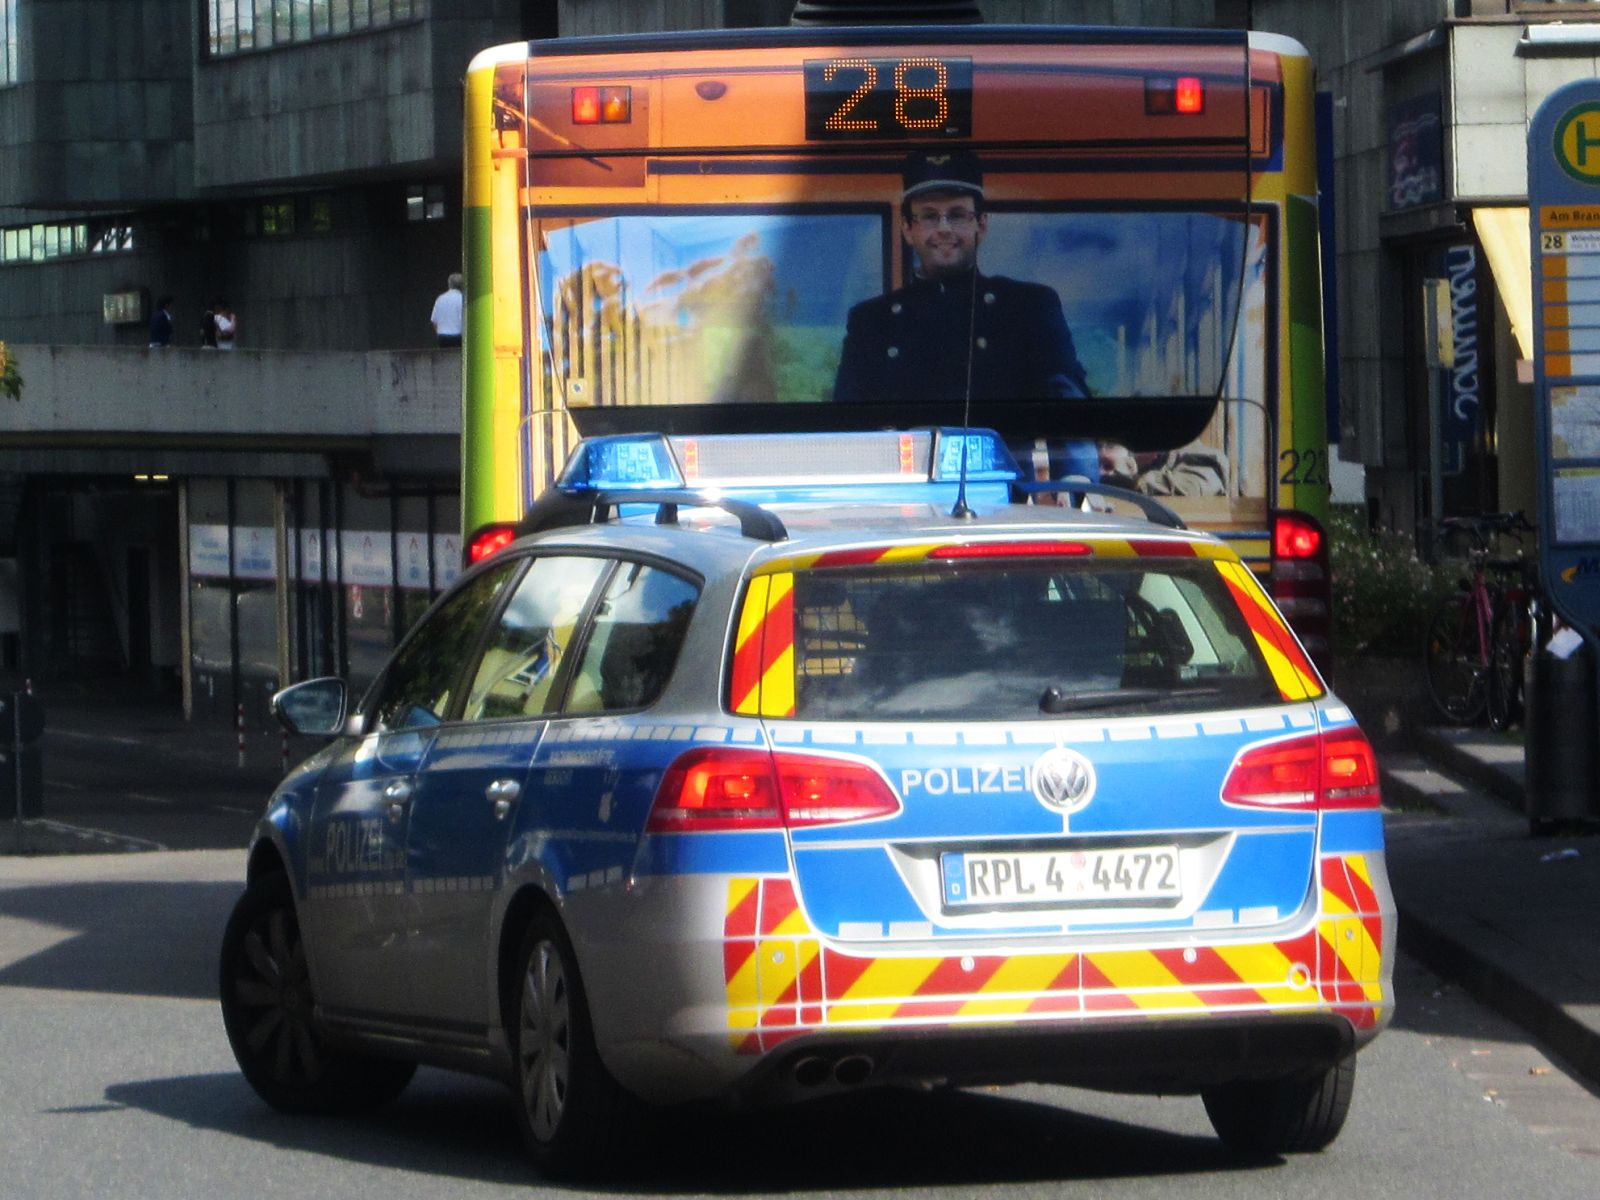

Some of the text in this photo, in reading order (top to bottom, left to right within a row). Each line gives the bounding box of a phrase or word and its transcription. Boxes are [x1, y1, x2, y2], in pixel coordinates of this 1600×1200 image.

[824, 58, 947, 129] 28
[1550, 210, 1570, 221] Am
[1543, 234, 1563, 249] 28
[902, 766, 1031, 796] POLIZEI
[968, 853, 1177, 897] RPL 4 4472
